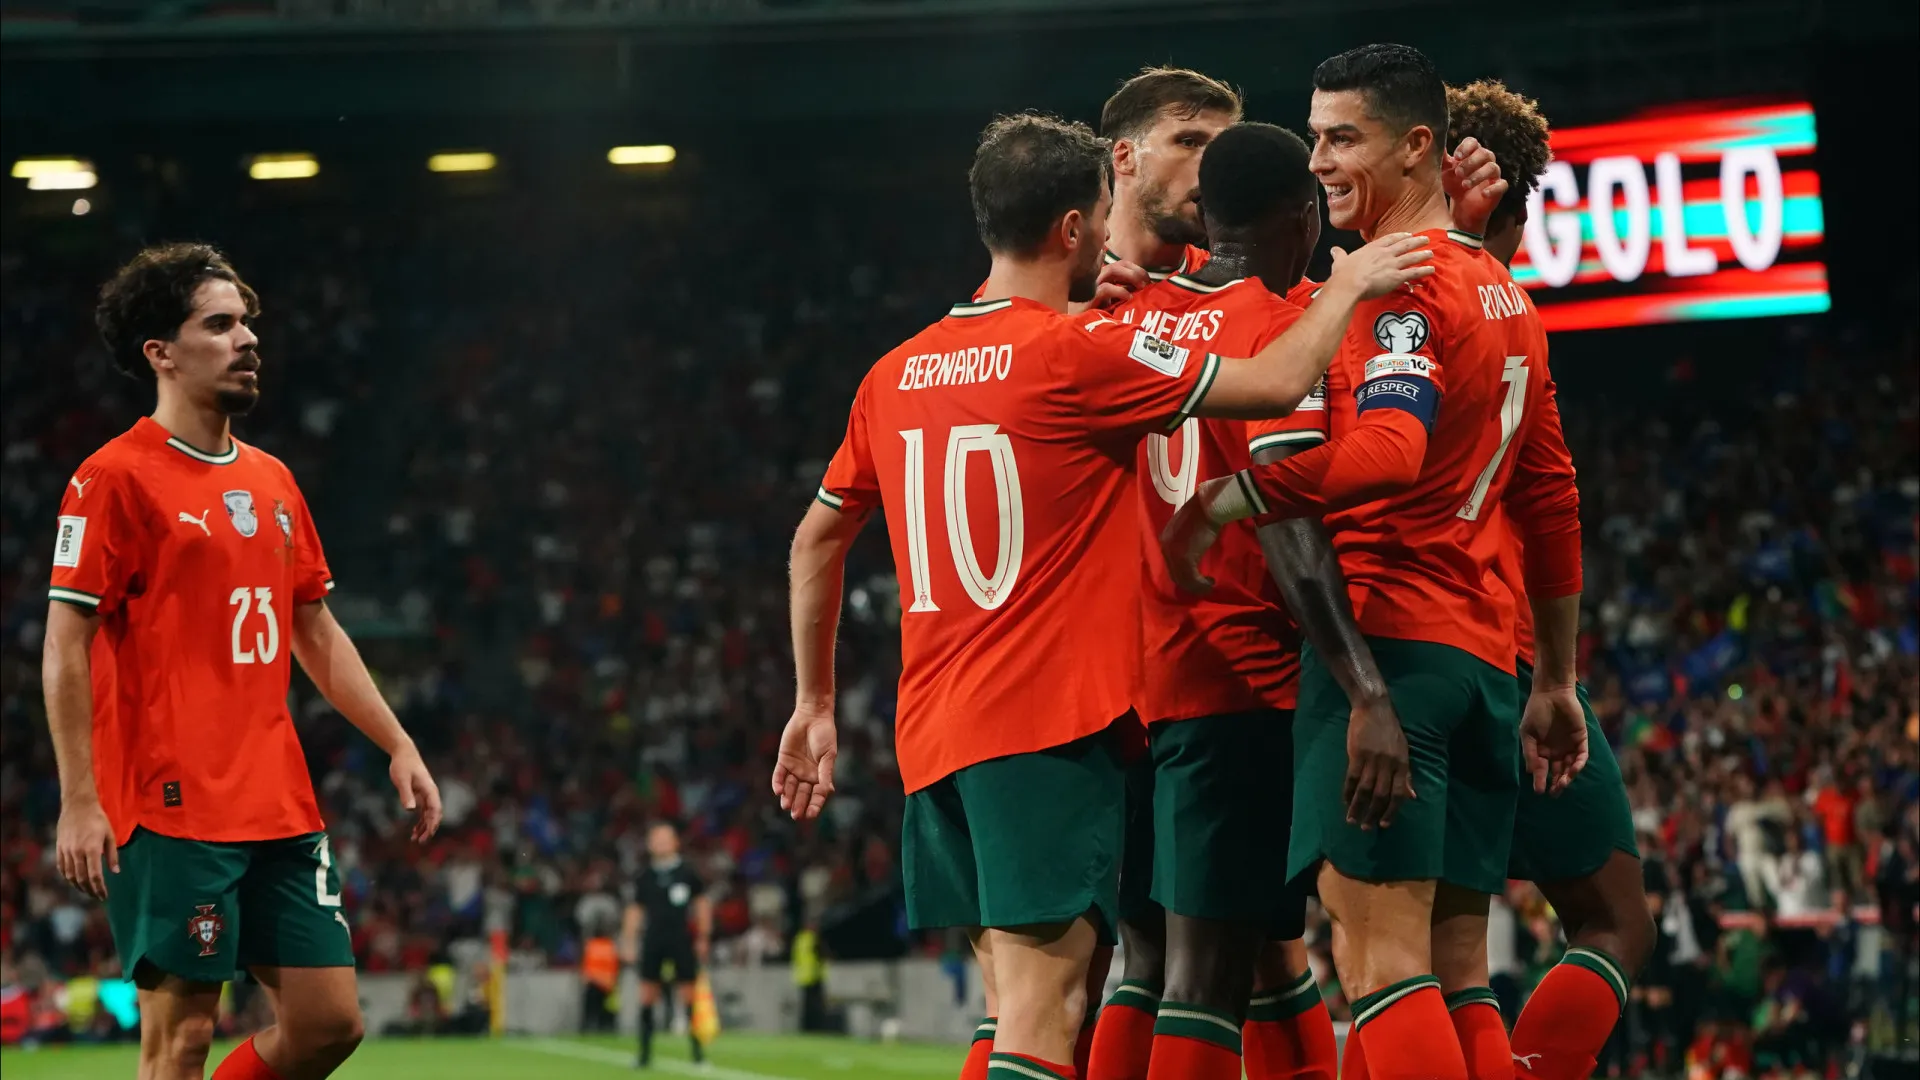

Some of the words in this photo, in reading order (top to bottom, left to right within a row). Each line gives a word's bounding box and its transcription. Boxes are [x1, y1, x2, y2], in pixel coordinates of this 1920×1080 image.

[1526, 145, 1784, 288] GOLO
[1140, 309, 1224, 342] MEDES
[898, 344, 1013, 390] BERNARDO
[1367, 382, 1420, 397] RESPECT
[898, 424, 1024, 613] 10
[229, 586, 280, 665] 23
